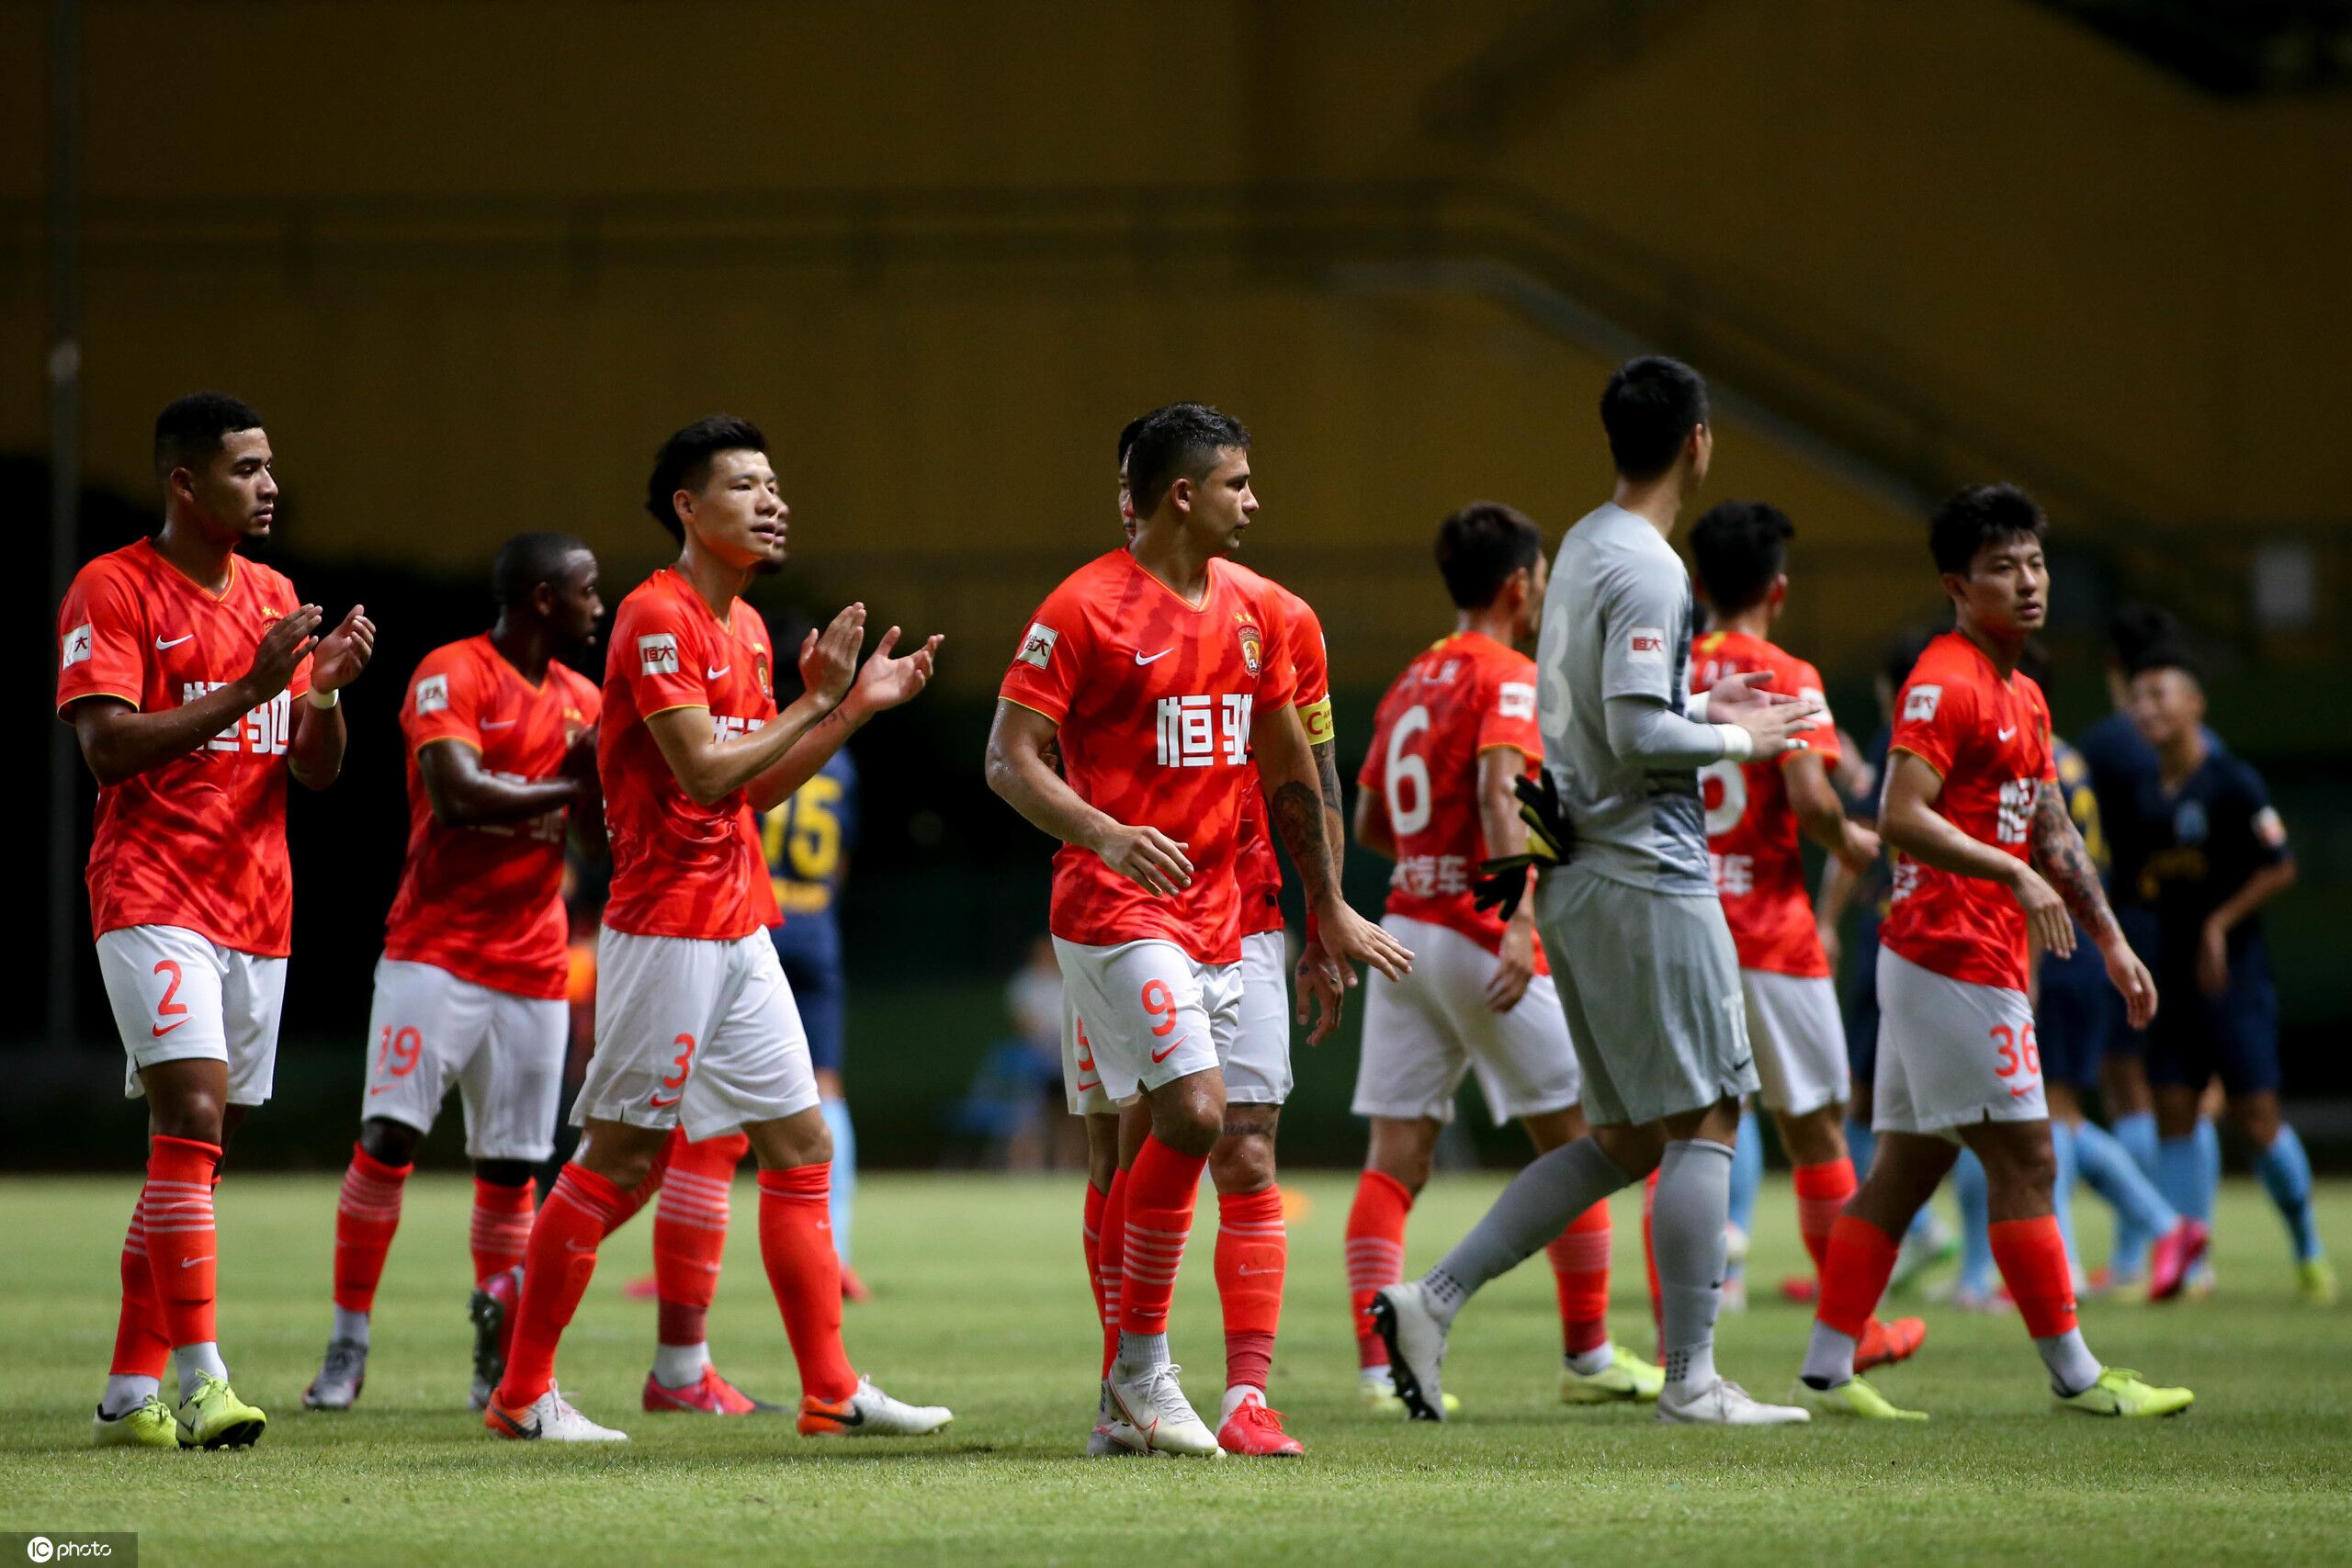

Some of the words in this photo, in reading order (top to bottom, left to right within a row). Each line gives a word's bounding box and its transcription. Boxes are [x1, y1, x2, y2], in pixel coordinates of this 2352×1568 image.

[644, 645, 674, 662] 恒大
[1307, 711, 1323, 735] C
[1385, 705, 1431, 837] 6
[153, 960, 187, 1015] 2
[1141, 979, 1177, 1037] 9
[377, 1025, 422, 1077] 19
[663, 1032, 695, 1089] 3
[1989, 1021, 2039, 1077] 36
